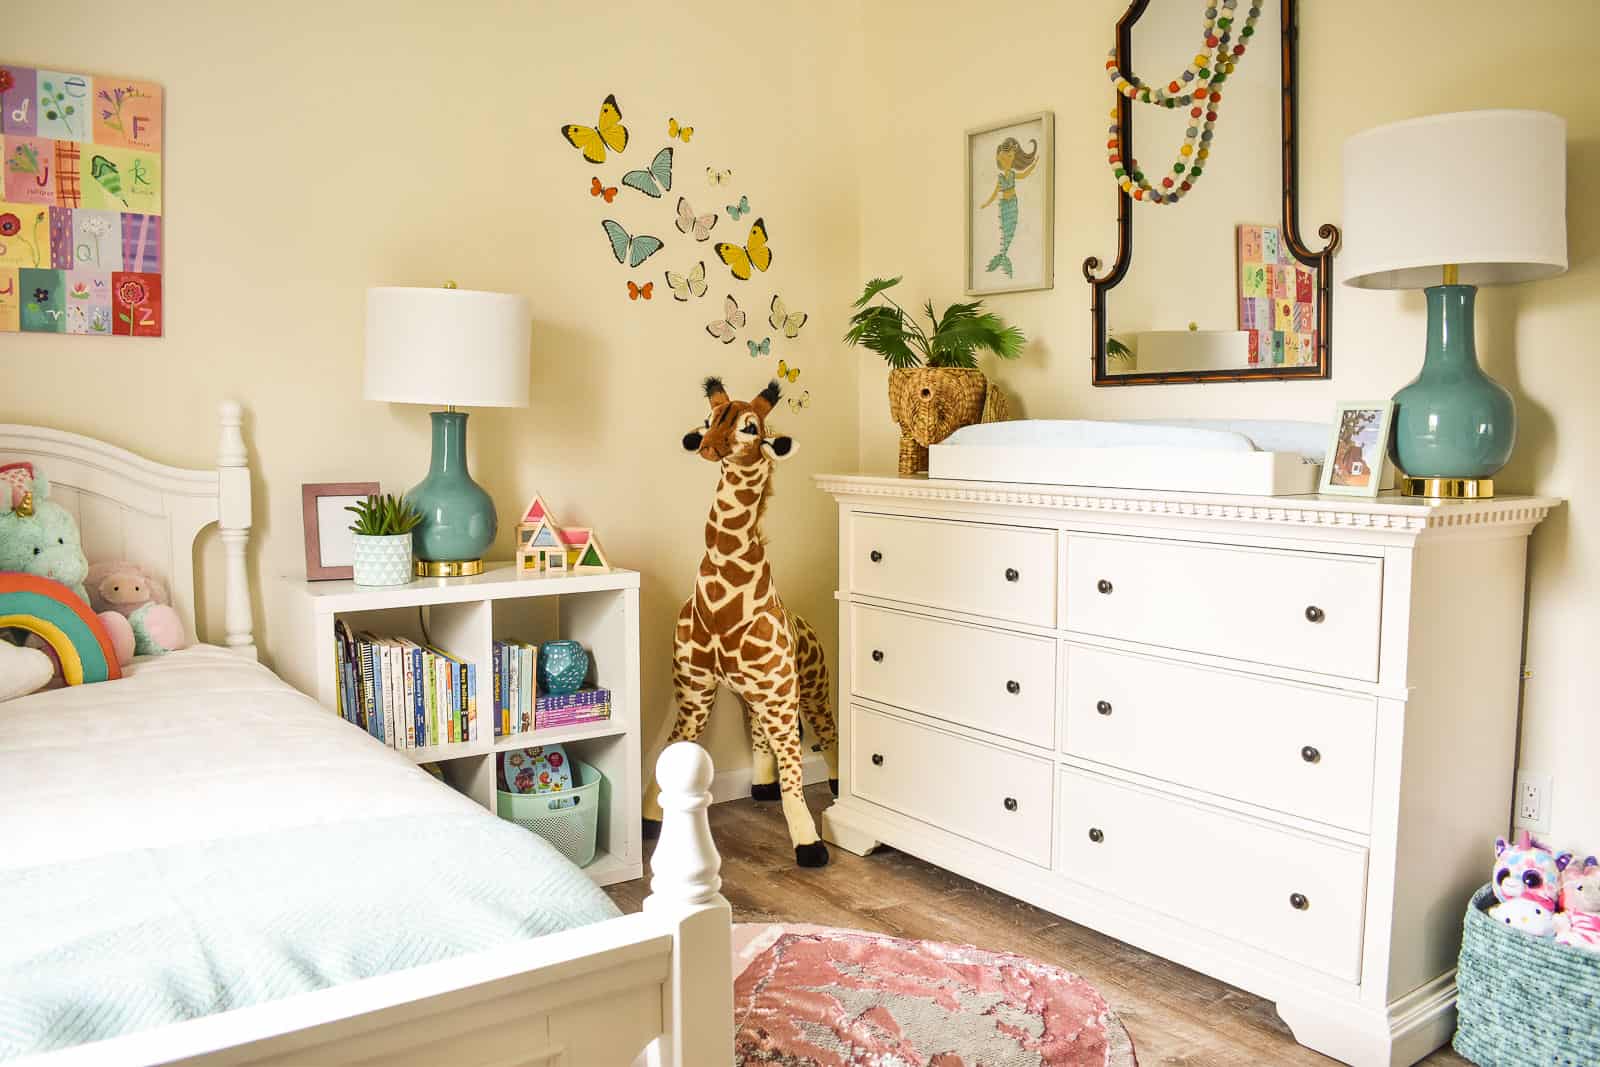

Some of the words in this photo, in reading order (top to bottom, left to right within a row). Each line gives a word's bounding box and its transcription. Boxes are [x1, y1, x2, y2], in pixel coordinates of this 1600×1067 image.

[12, 98, 29, 123] d
[133, 116, 150, 139] F
[77, 244, 92, 262] Q
